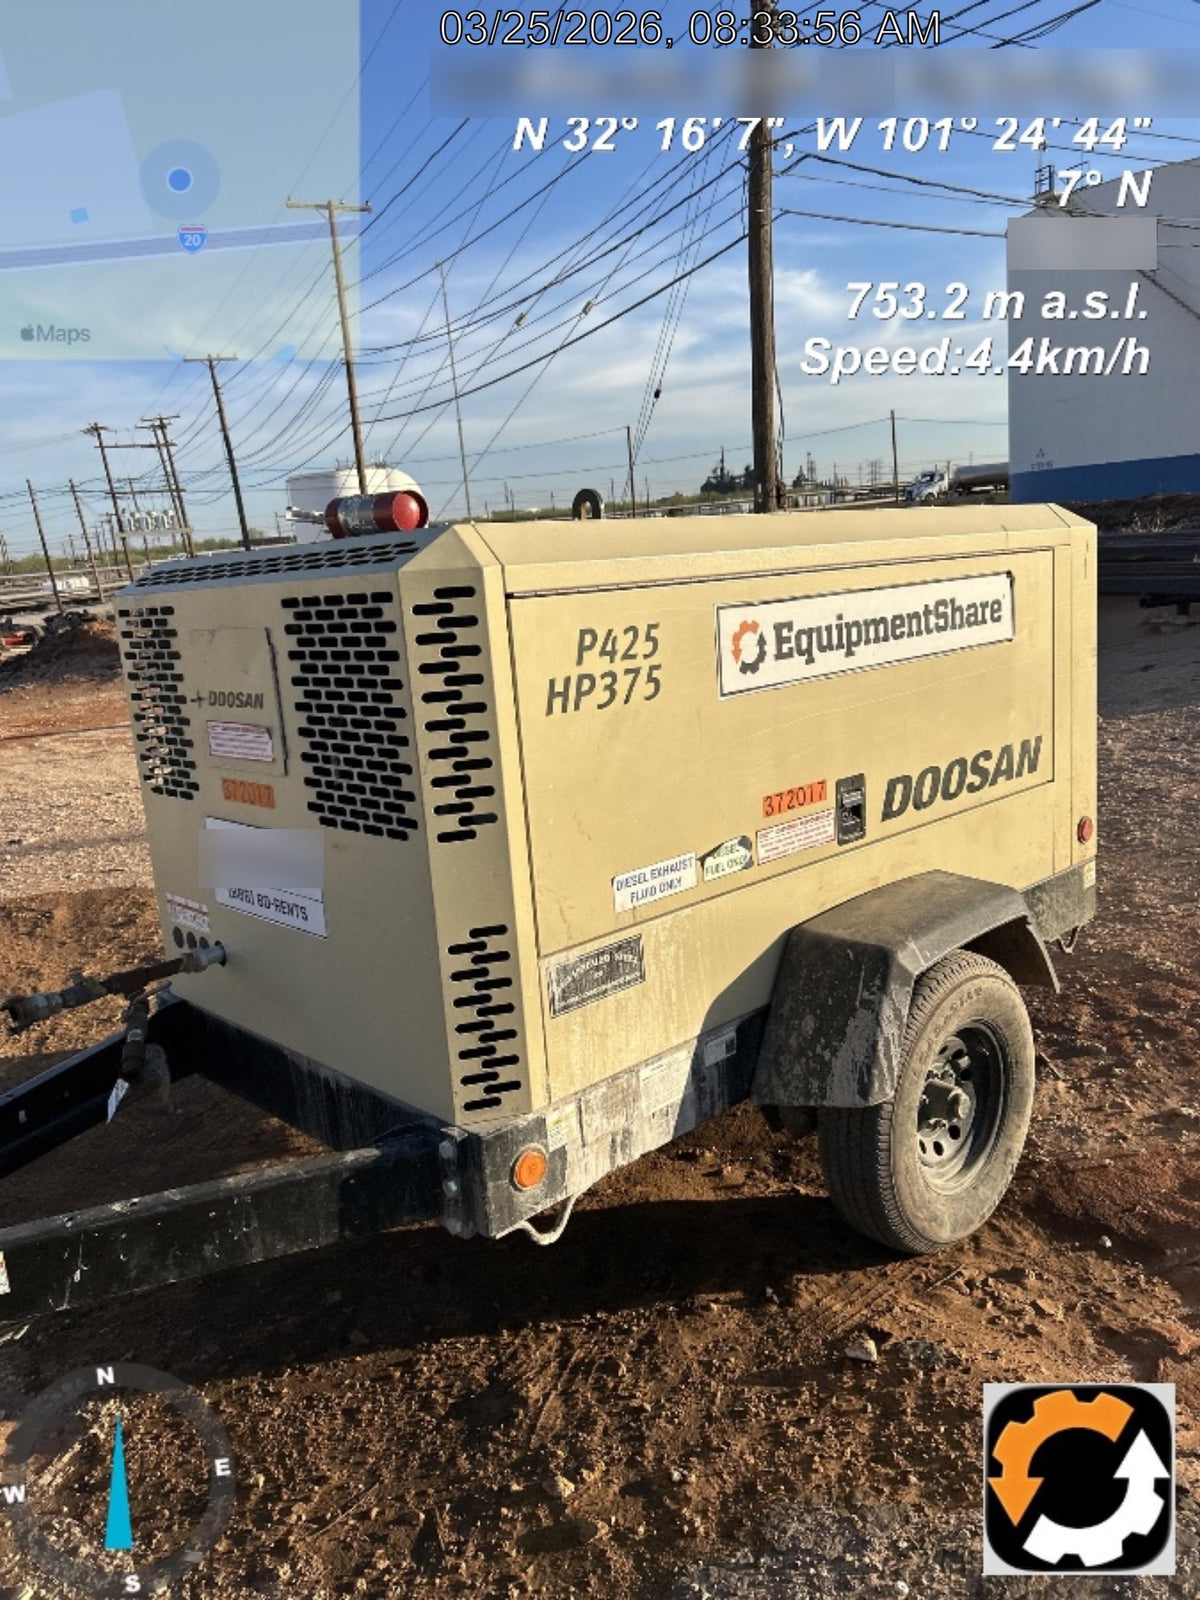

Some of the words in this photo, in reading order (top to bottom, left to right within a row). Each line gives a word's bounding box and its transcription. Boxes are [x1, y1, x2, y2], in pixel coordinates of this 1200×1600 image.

[576, 622, 660, 667] P425
[772, 597, 1003, 665] EquipmentShare
[208, 691, 264, 709] DOOSAN
[545, 663, 662, 717] HP375
[764, 780, 826, 816] 372017
[881, 735, 1043, 822] DOOSAN
[616, 872, 649, 892] DIESEL
[650, 857, 694, 880] EXHAUST
[630, 885, 657, 904] FLUID
[659, 876, 682, 893] ONLY
